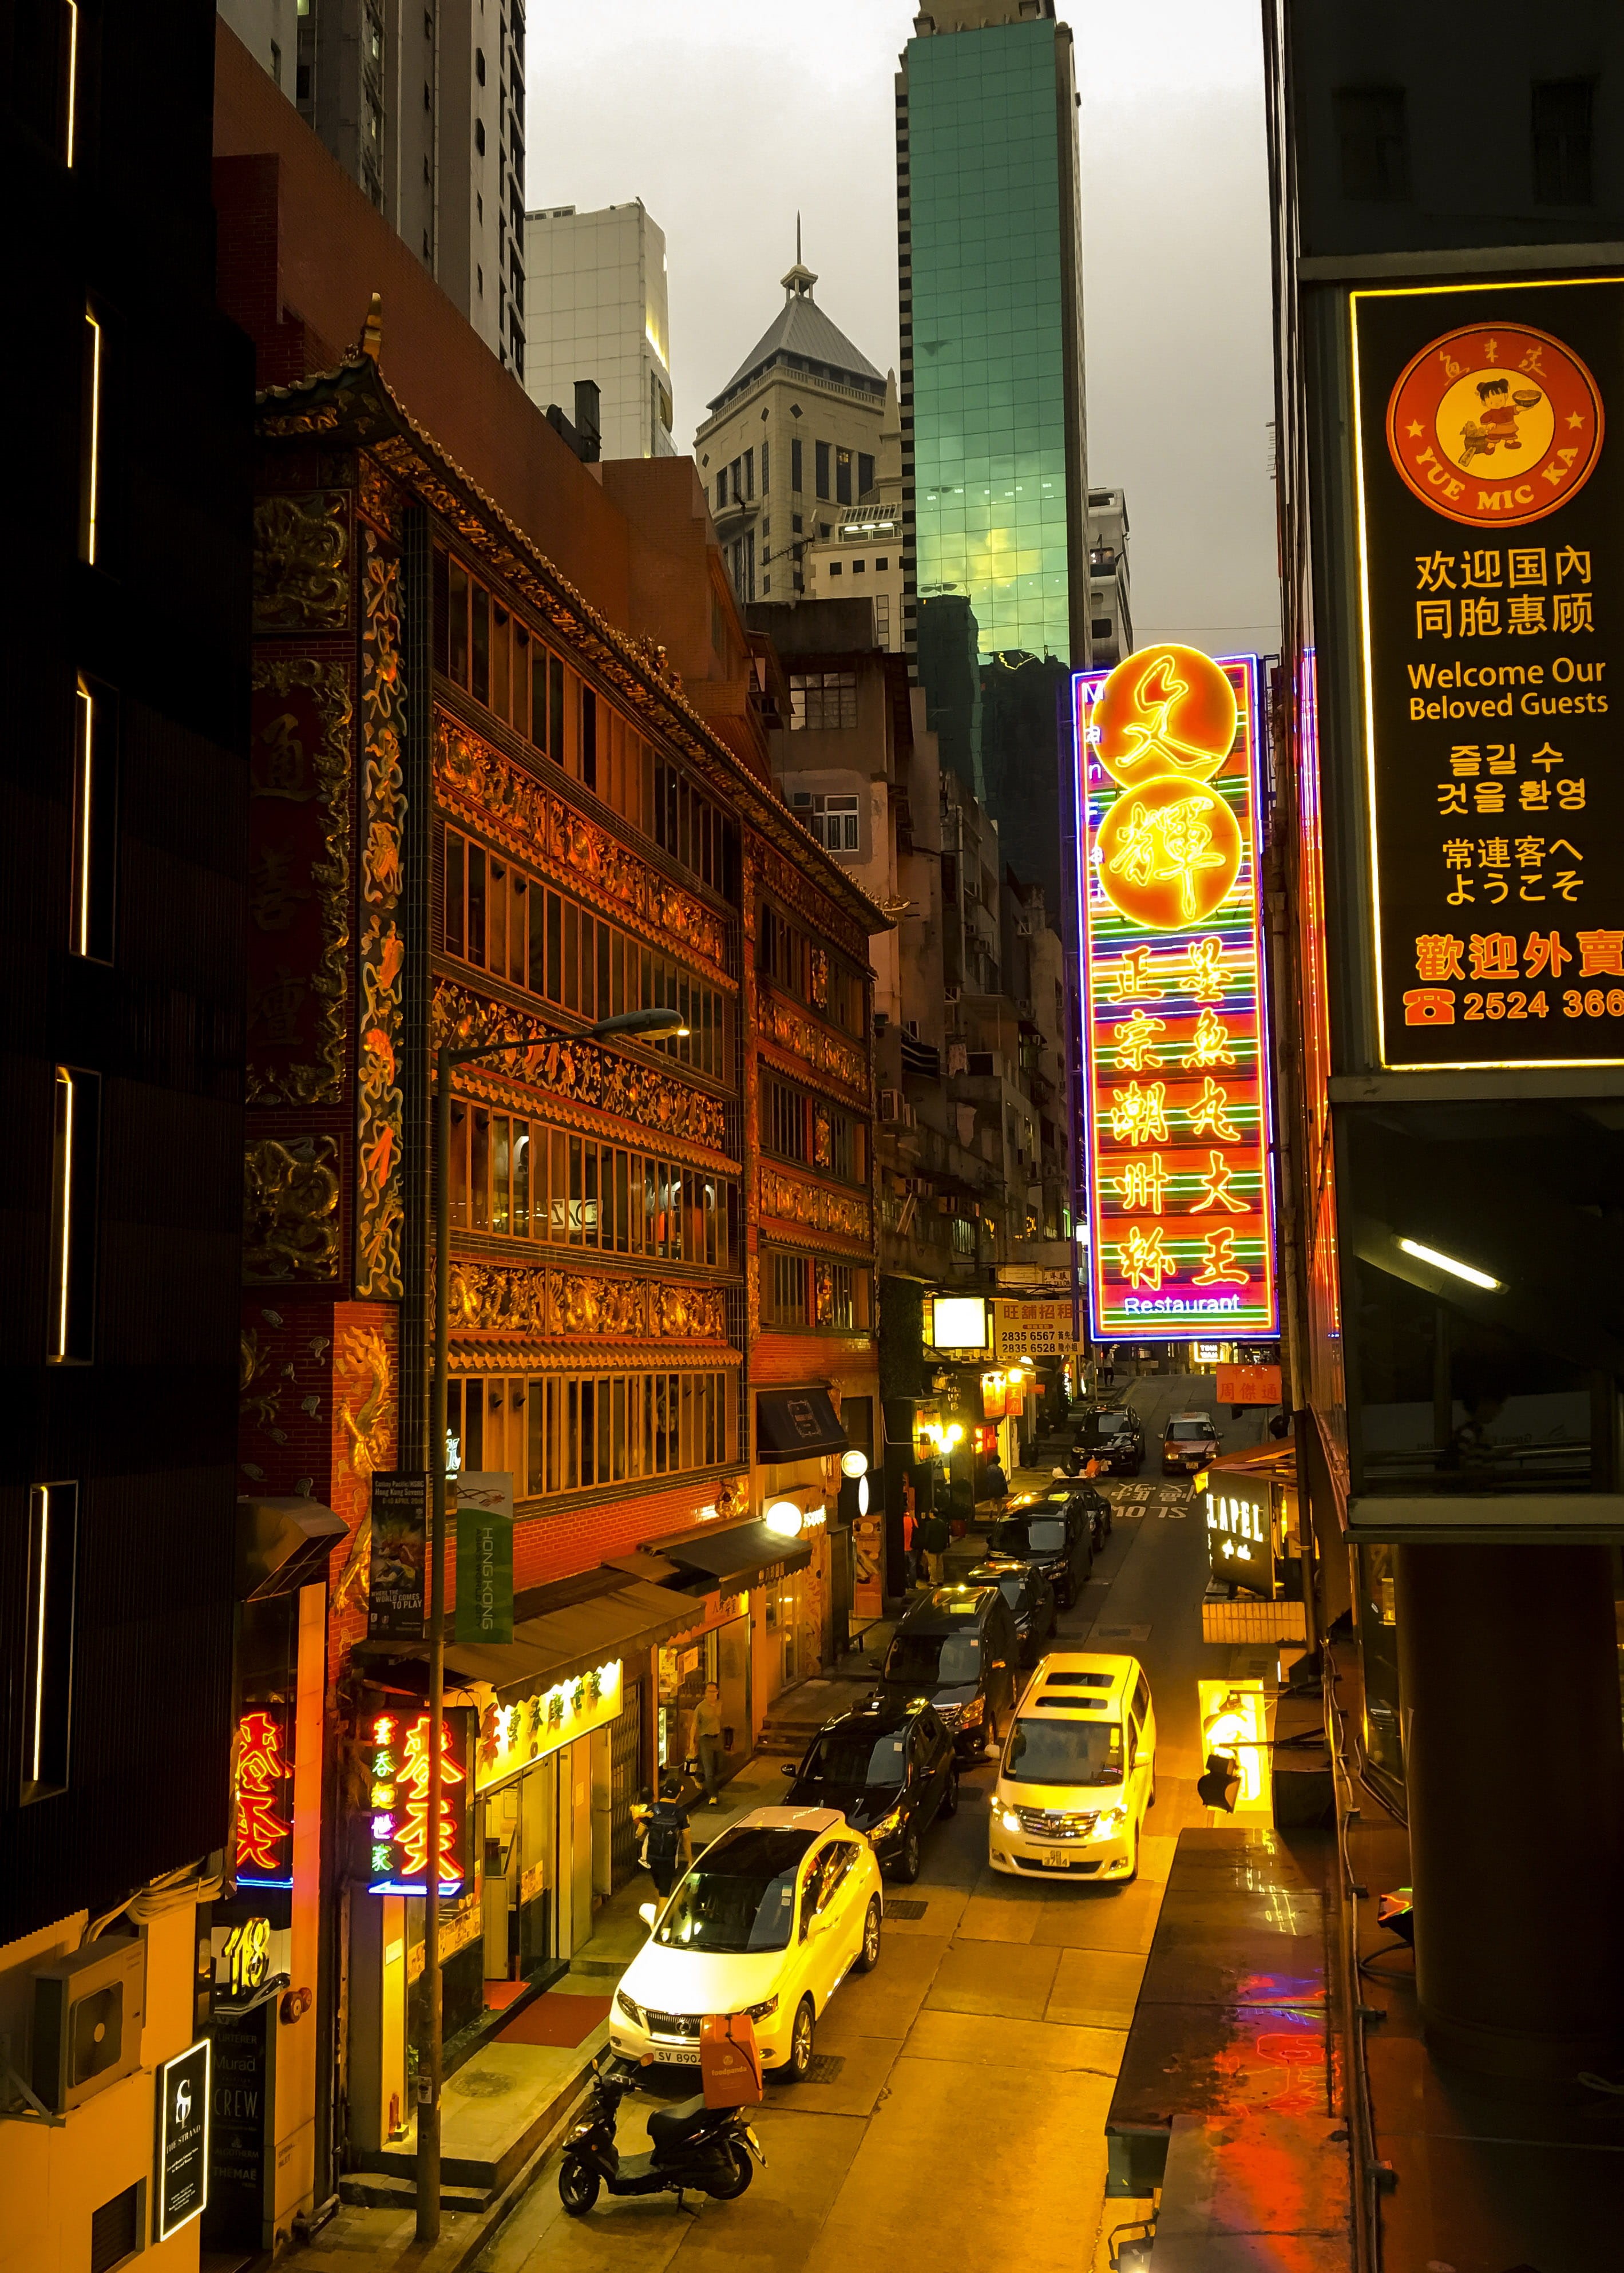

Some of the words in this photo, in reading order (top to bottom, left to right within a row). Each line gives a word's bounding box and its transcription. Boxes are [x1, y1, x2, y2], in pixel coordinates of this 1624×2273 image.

[1416, 446, 1465, 501] YUE
[1477, 485, 1534, 510] MIC
[1542, 448, 1578, 485] KA
[1416, 592, 1595, 639] 同胞惠顾
[1407, 661, 1544, 690] Welcome
[1552, 657, 1606, 683] Our
[1410, 693, 1513, 720] Beloved
[1520, 692, 1609, 715] Guests
[1449, 743, 1517, 776] 즐길
[1531, 742, 1564, 773] 수
[1437, 782, 1506, 815] 것을
[1519, 778, 1586, 810] 환영
[1443, 835, 1584, 870] 常連客へ
[1447, 870, 1584, 905] ようこそ
[1416, 929, 1624, 980] 歡迎外賣
[1464, 991, 1549, 1020] 2524
[1179, 936, 1251, 1286] 墨魚丸大王
[1124, 1294, 1241, 1316] Restaurant
[1002, 1332, 1027, 1341] 2835
[1030, 1331, 1055, 1341] 6567
[1058, 1331, 1074, 1340] 黃先
[1003, 1344, 1027, 1353] 2835
[1030, 1344, 1055, 1352] 6528
[482, 1527, 493, 1577] HONG
[375, 1594, 397, 1603] WORLD
[398, 1593, 420, 1601] COMES
[392, 1601, 402, 1610] TO
[403, 1599, 422, 1609] PLAY
[482, 1580, 493, 1630] KONG
[213, 2054, 256, 2072] Murad
[657, 2052, 672, 2062] SV
[676, 2053, 700, 2064] 890
[712, 2066, 747, 2076] foodpanda
[167, 2141, 176, 2155] THE
[178, 2124, 201, 2147] STRAND
